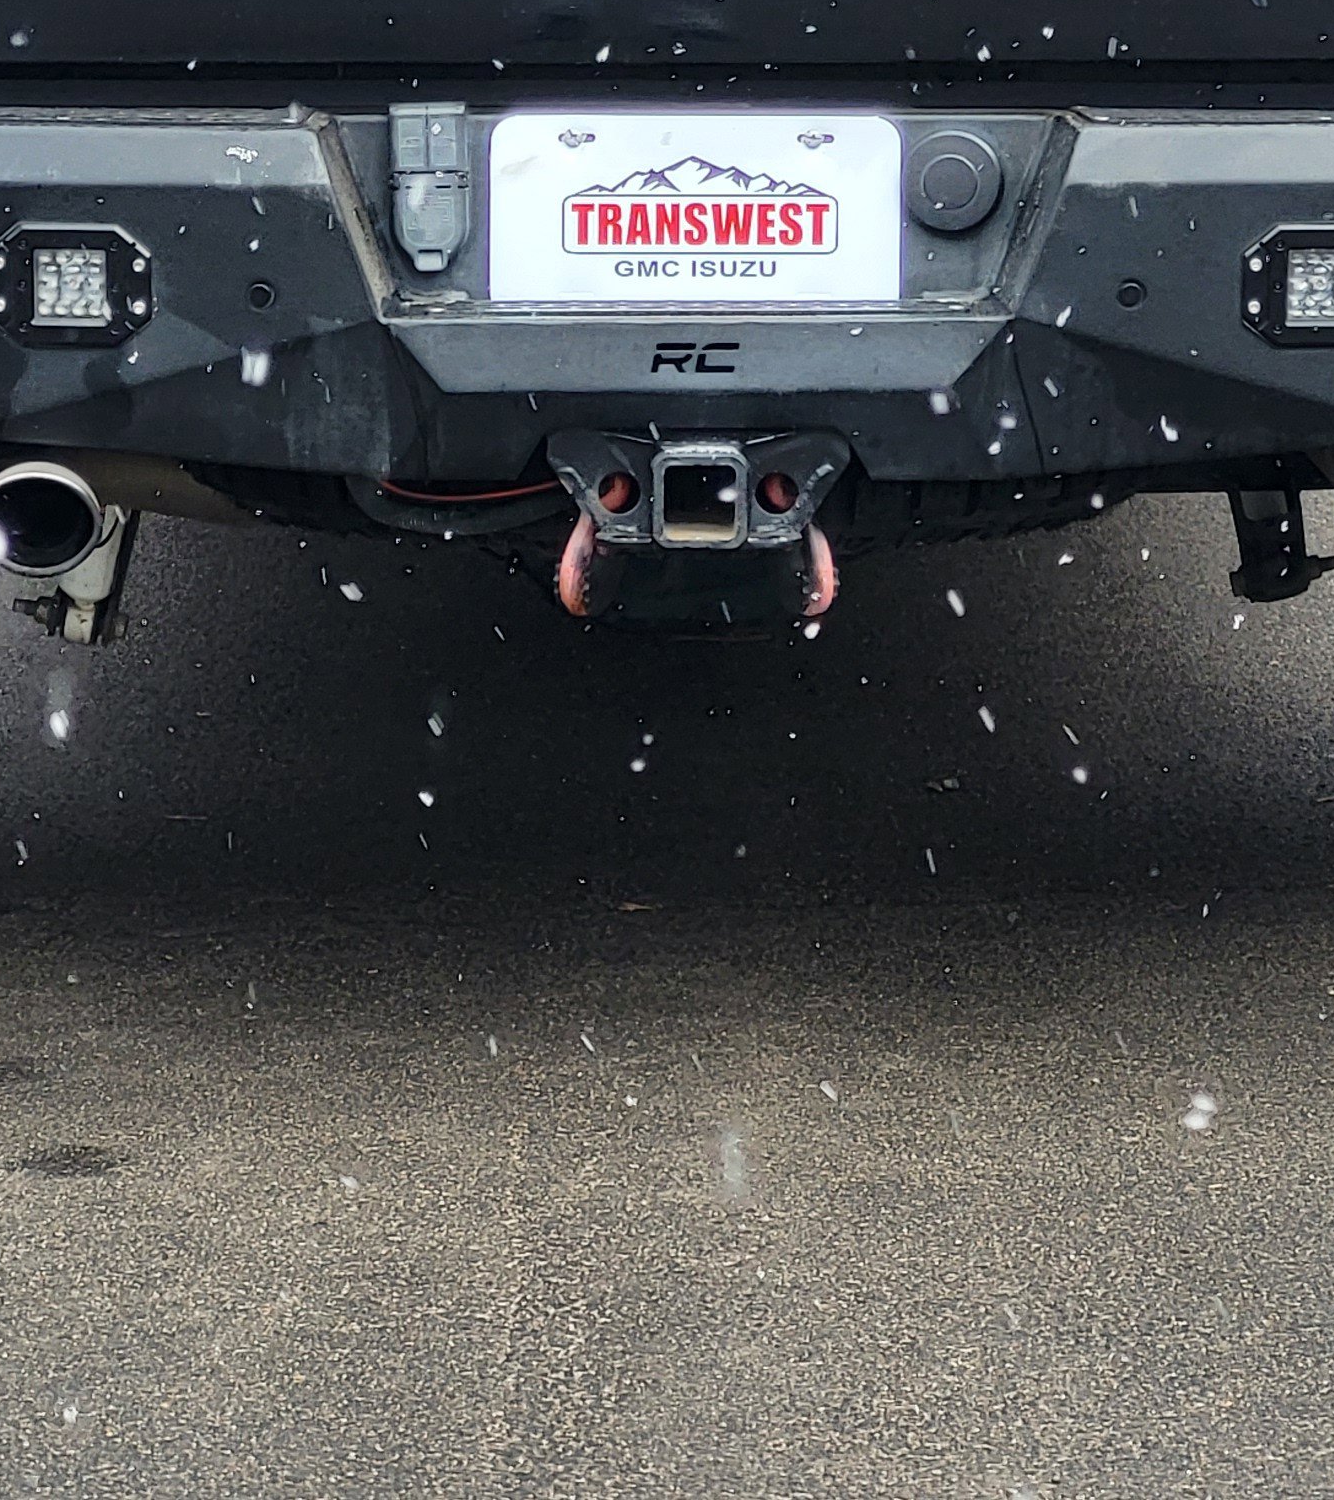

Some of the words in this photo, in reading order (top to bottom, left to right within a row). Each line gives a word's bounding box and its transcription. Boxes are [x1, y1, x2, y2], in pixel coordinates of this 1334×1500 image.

[571, 202, 830, 246] TRANSWEST
[614, 260, 680, 278] GMC
[691, 260, 777, 278] ISUZU
[650, 342, 740, 373] RC
